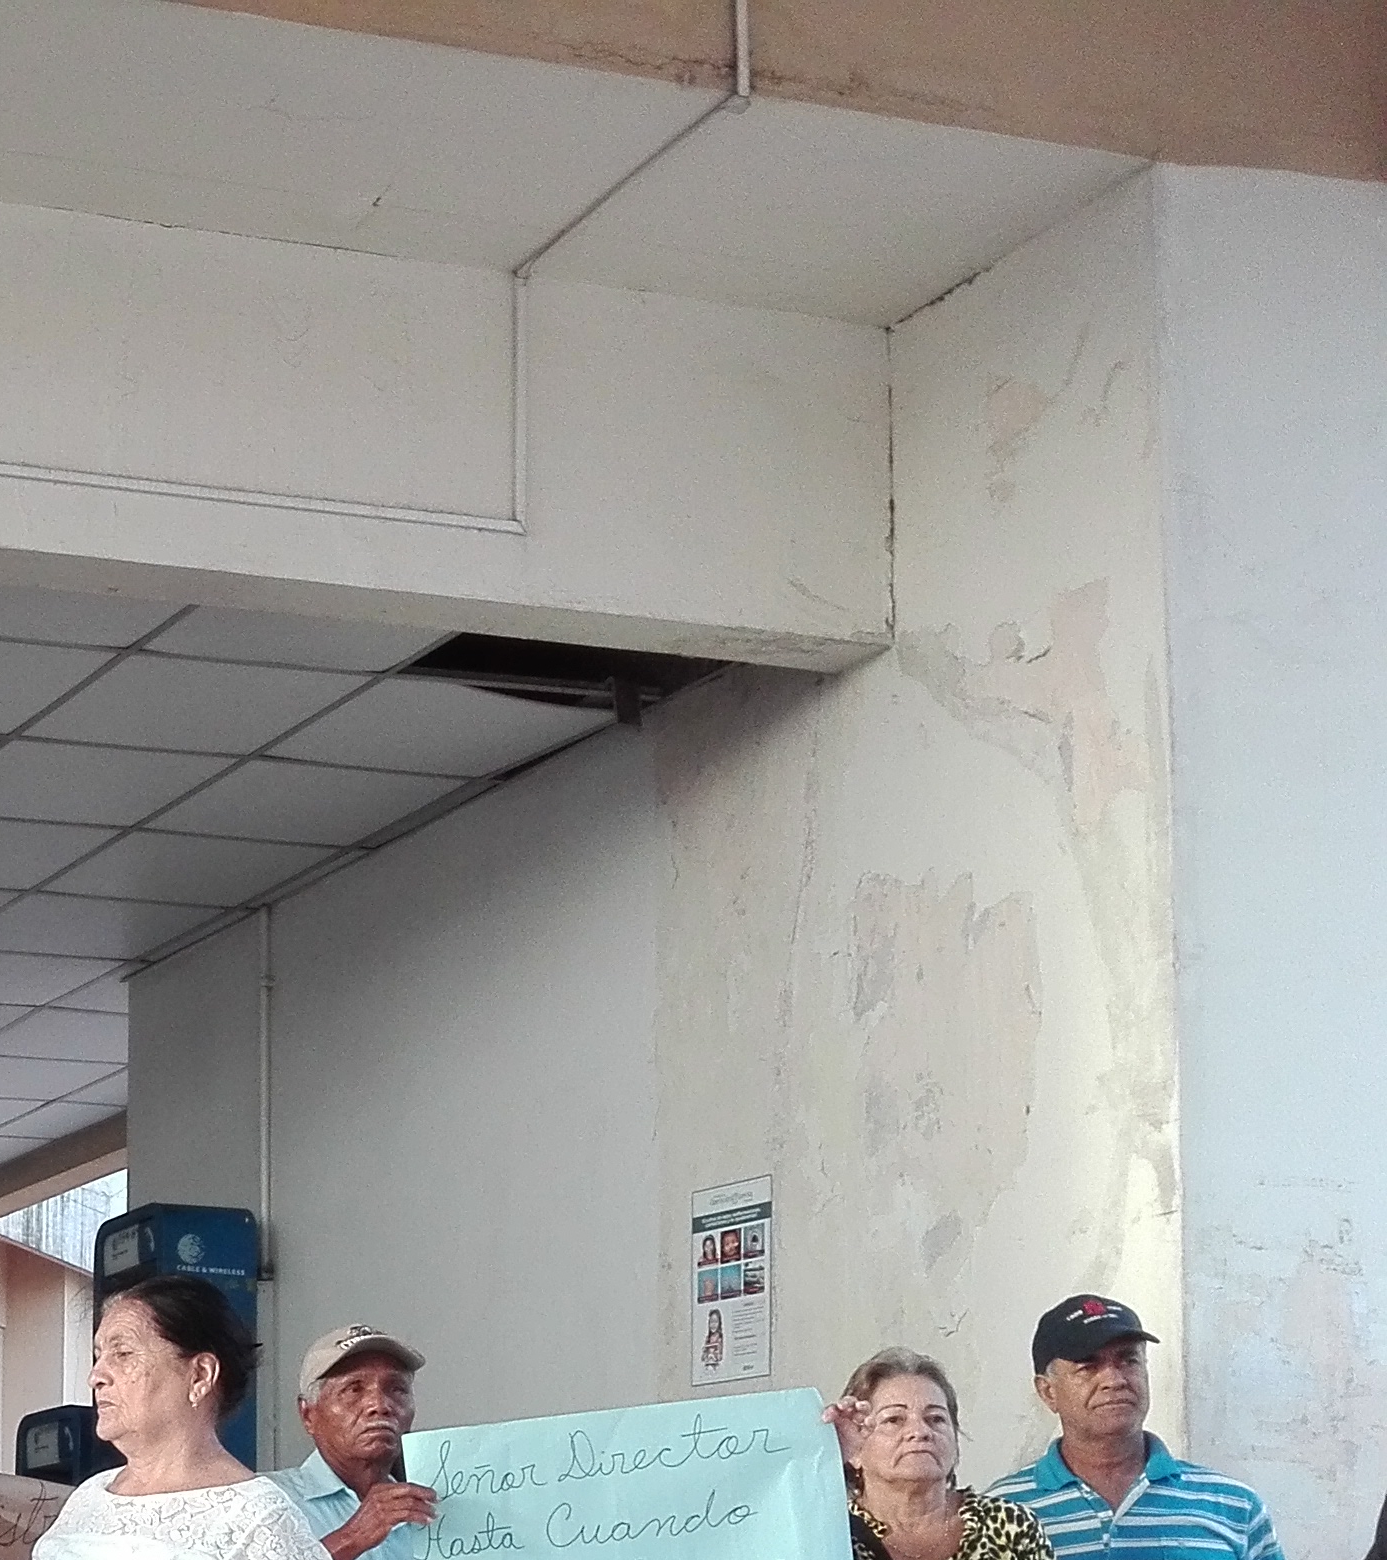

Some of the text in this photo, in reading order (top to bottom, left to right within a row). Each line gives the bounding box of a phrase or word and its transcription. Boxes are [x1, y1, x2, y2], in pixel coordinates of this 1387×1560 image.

[176, 1264, 200, 1273] CABLE
[208, 1267, 246, 1277] WIRELESS
[429, 1412, 791, 1503] Señor Director
[545, 1489, 759, 1549] Cuando
